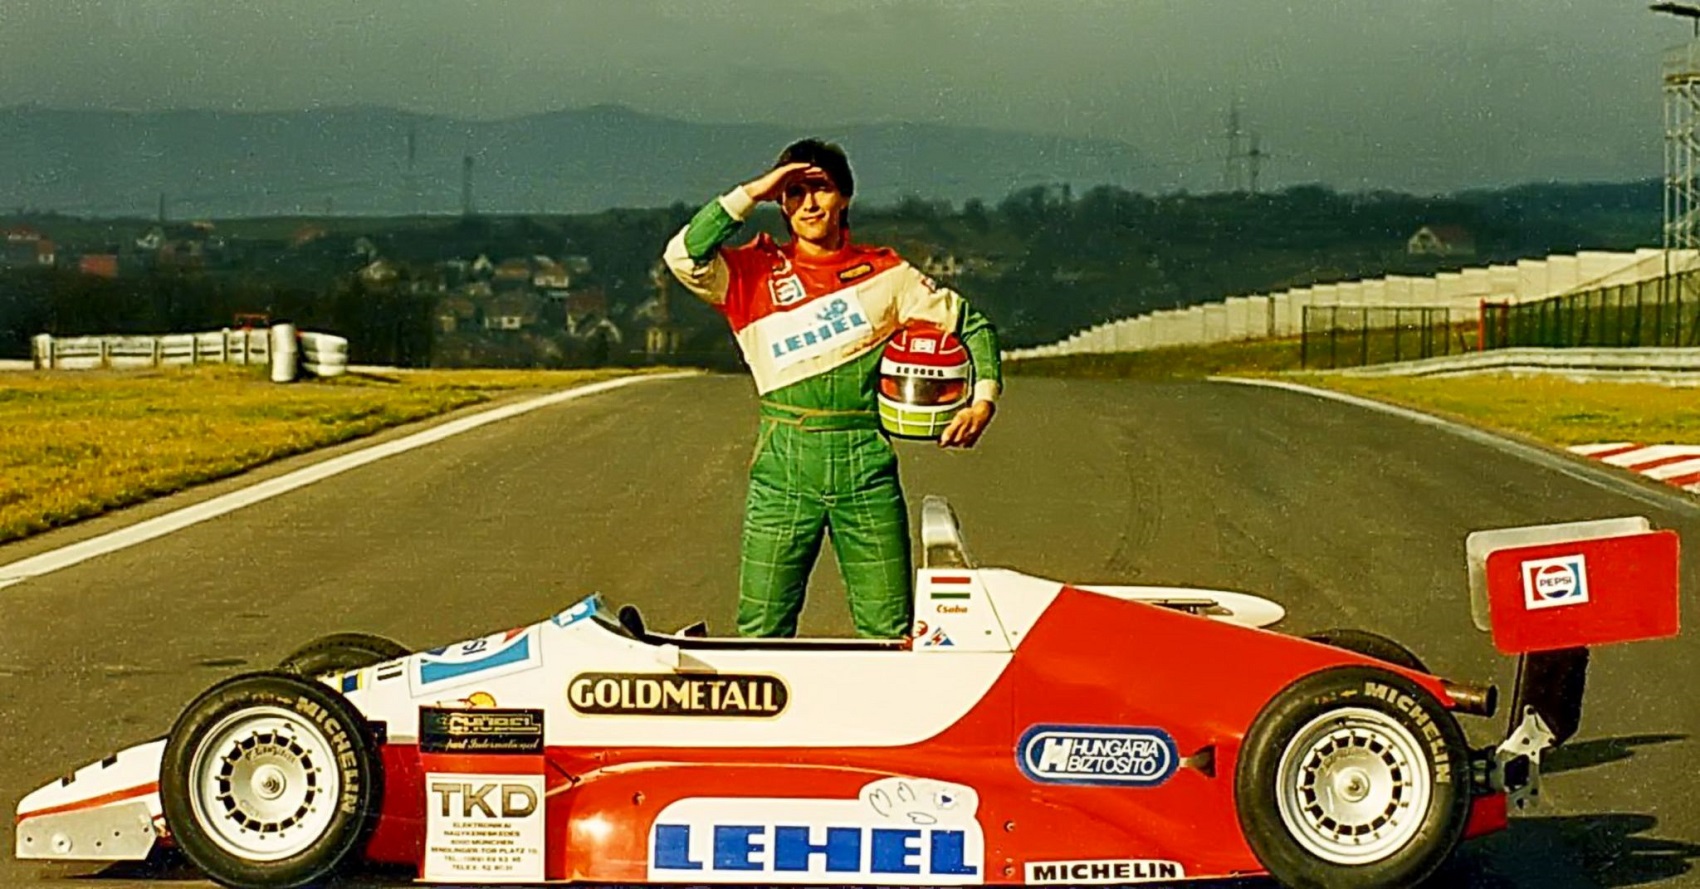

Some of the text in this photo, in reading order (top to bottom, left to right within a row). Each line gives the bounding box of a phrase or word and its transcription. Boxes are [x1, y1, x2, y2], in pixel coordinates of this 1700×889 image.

[772, 313, 866, 358] LEHEL
[1539, 576, 1572, 588] PEPSI
[570, 679, 778, 711] GOLDMETALL
[1365, 682, 1451, 784] MICHELIN
[295, 696, 359, 814] MICHELIN
[432, 783, 538, 818] TKD
[653, 824, 978, 876] LEHEL
[1033, 863, 1177, 881] MICHELIN
